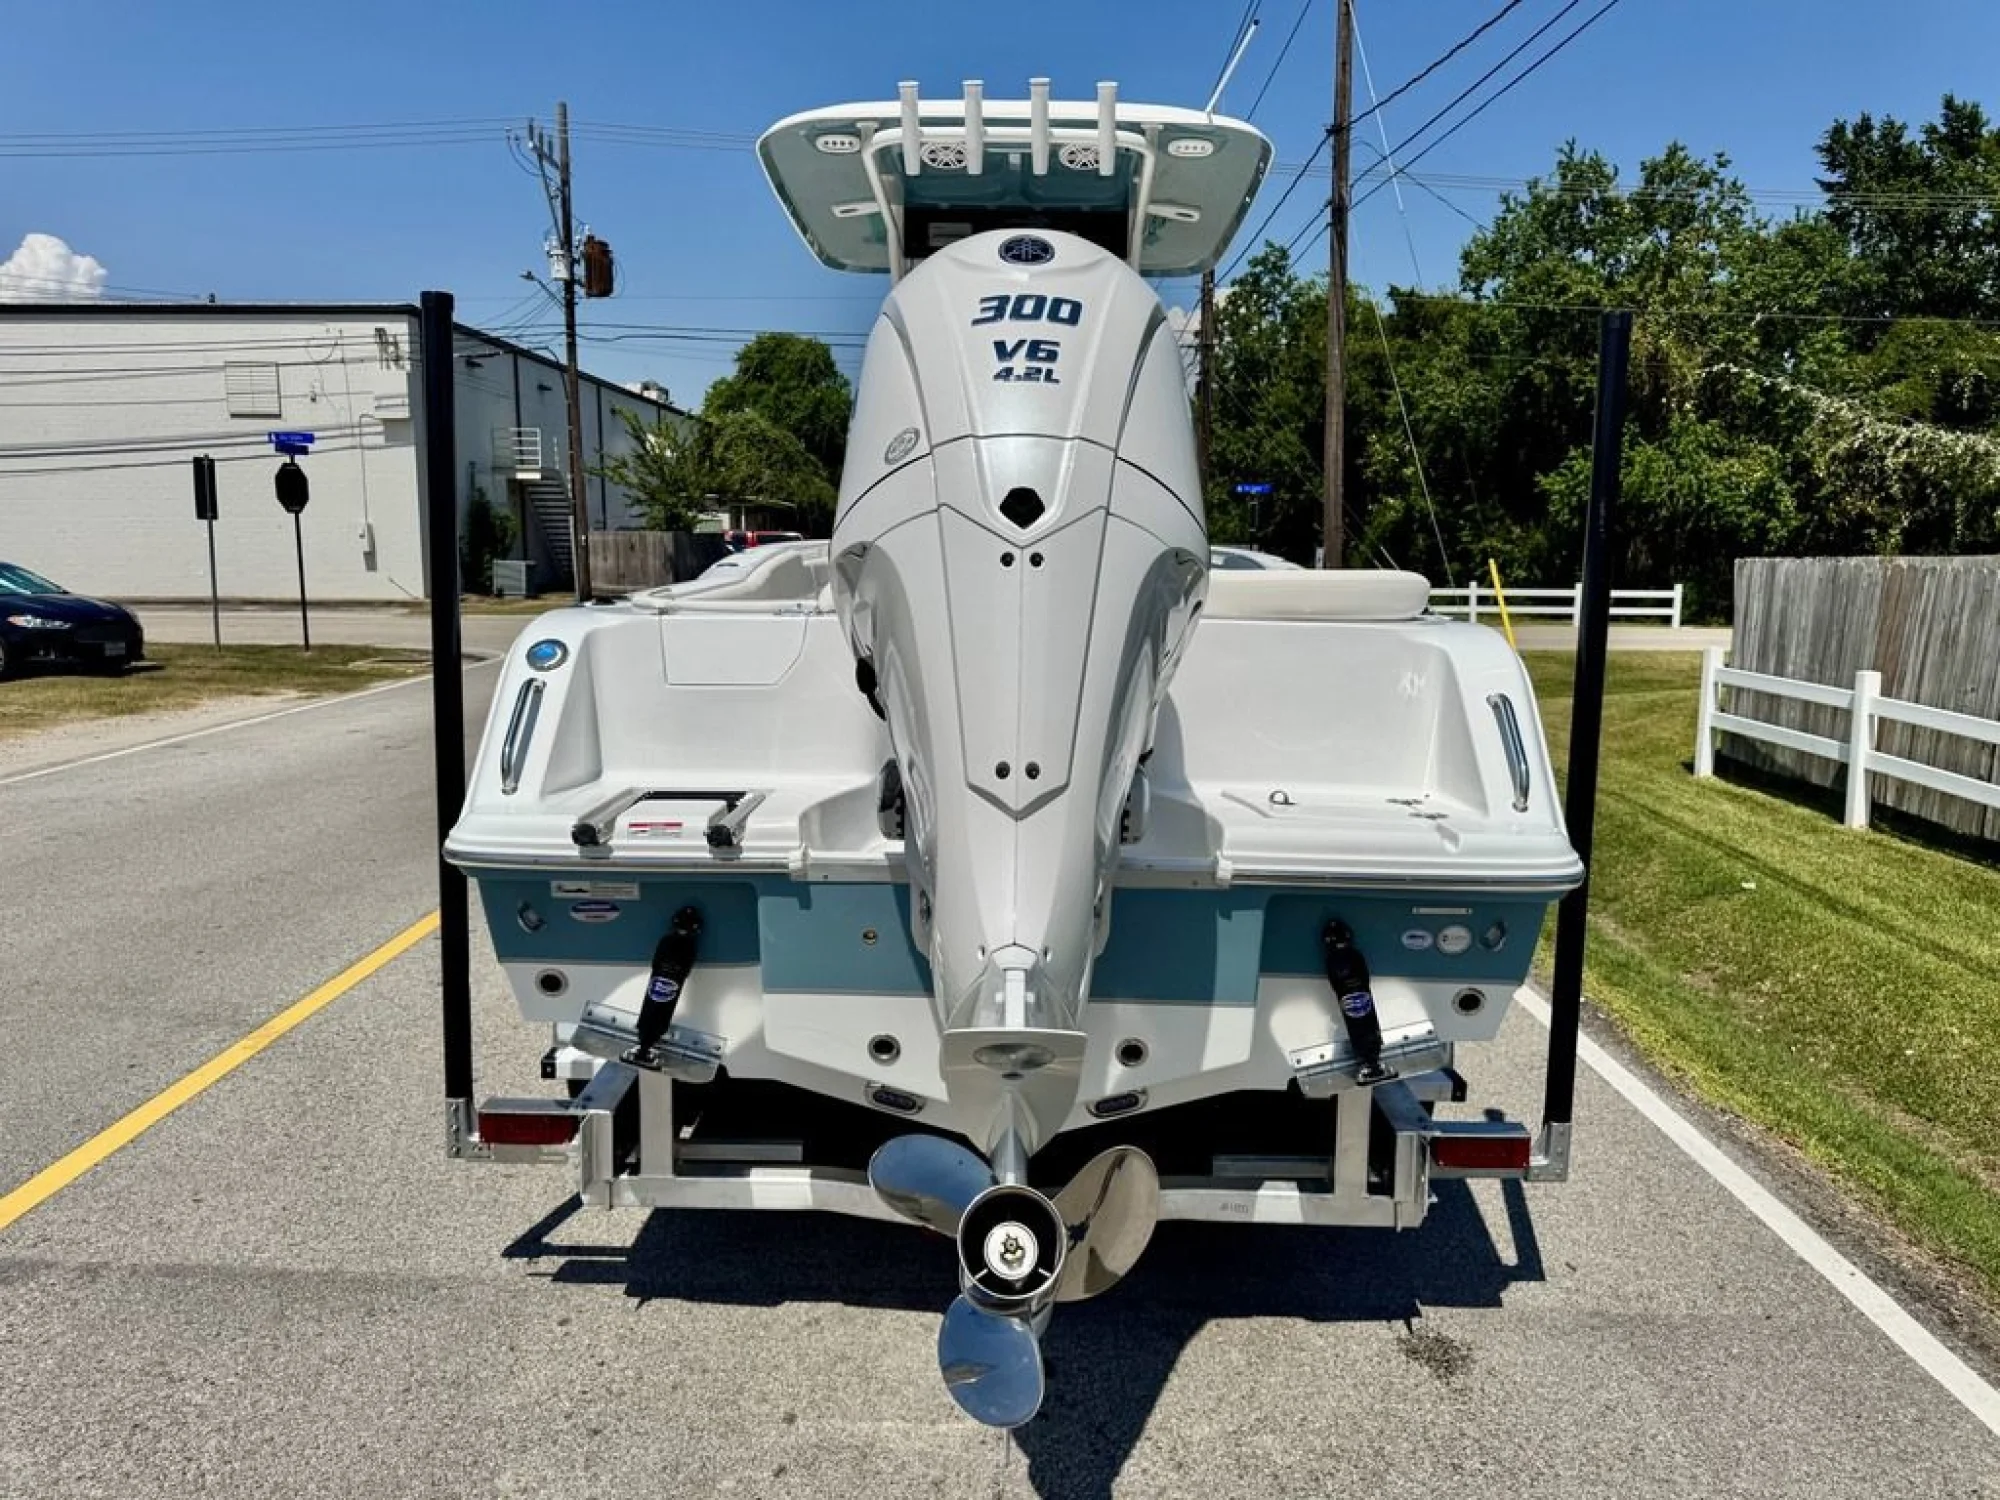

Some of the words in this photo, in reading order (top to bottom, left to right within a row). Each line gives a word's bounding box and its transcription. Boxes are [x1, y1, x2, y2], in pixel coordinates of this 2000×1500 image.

[971, 294, 1082, 327] 300
[993, 339, 1061, 363] V6
[993, 366, 1060, 384] 4.2L
